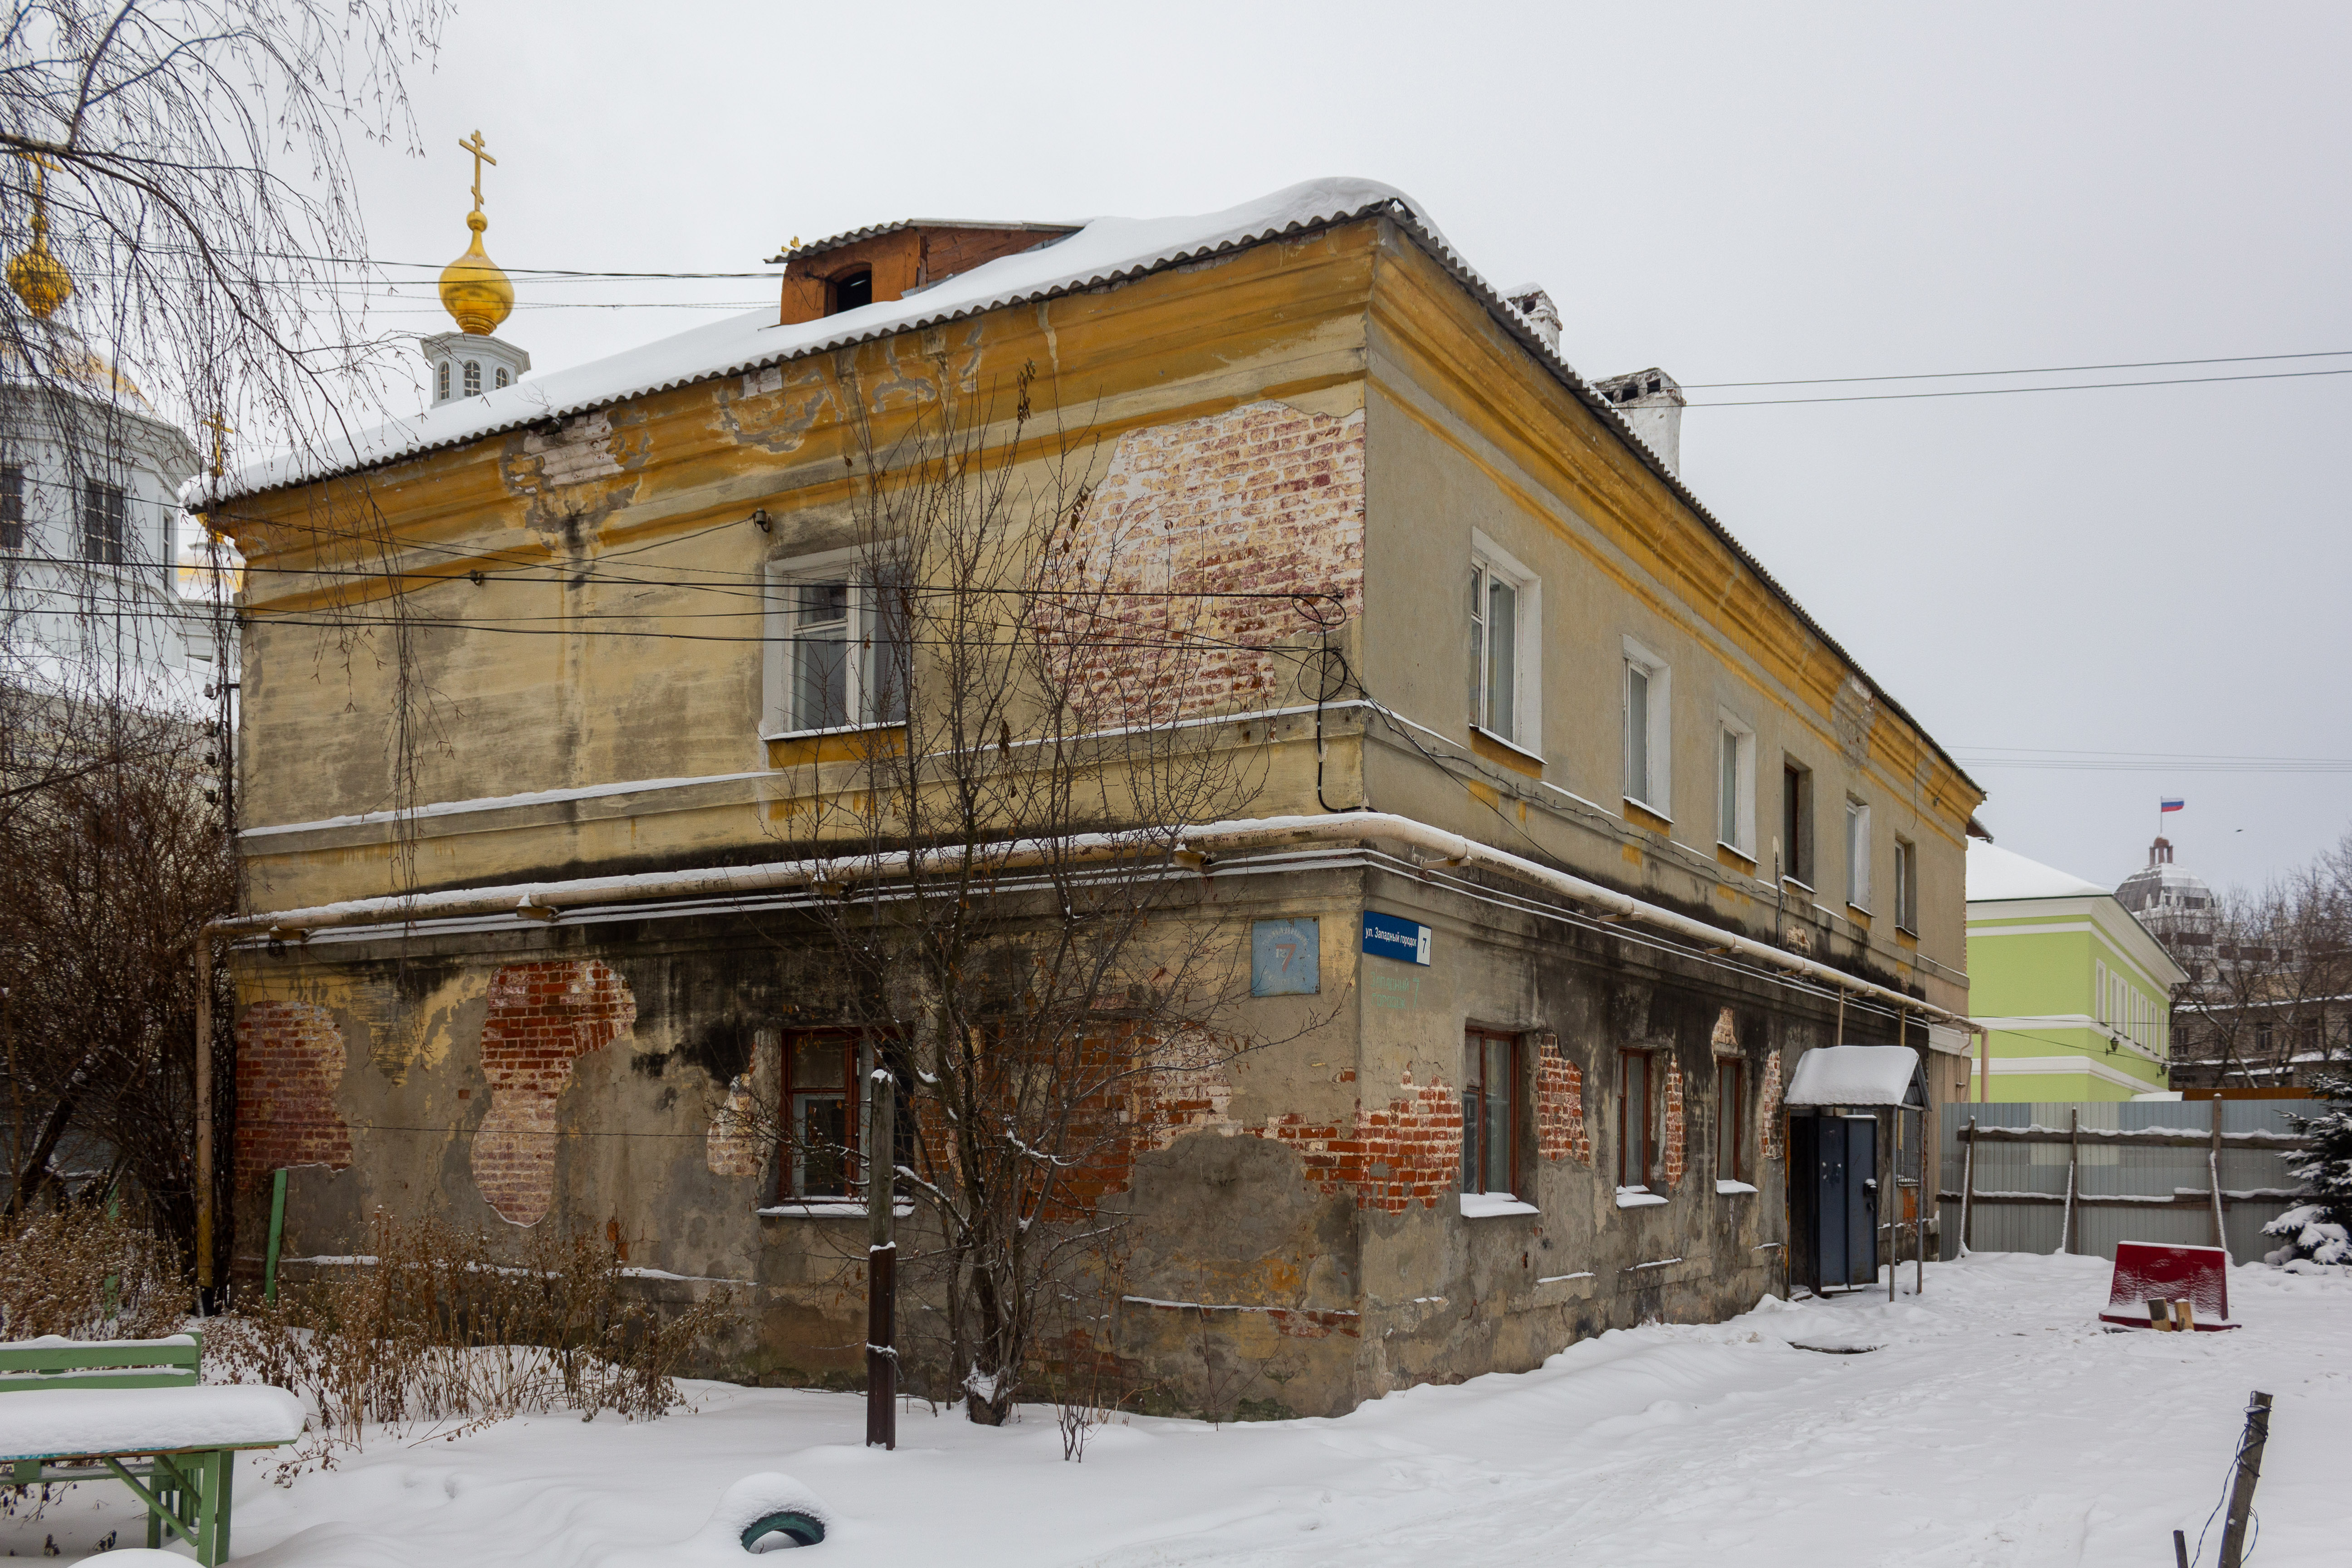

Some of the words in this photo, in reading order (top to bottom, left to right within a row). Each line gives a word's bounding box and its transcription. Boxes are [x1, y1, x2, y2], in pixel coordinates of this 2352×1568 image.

[1365, 927, 1373, 939] ул.
[1374, 927, 1399, 942] Западный
[1400, 935, 1417, 947] городок
[1422, 937, 1427, 954] 7
[1276, 944, 1297, 973] 7
[1412, 977, 1420, 1010] 7
